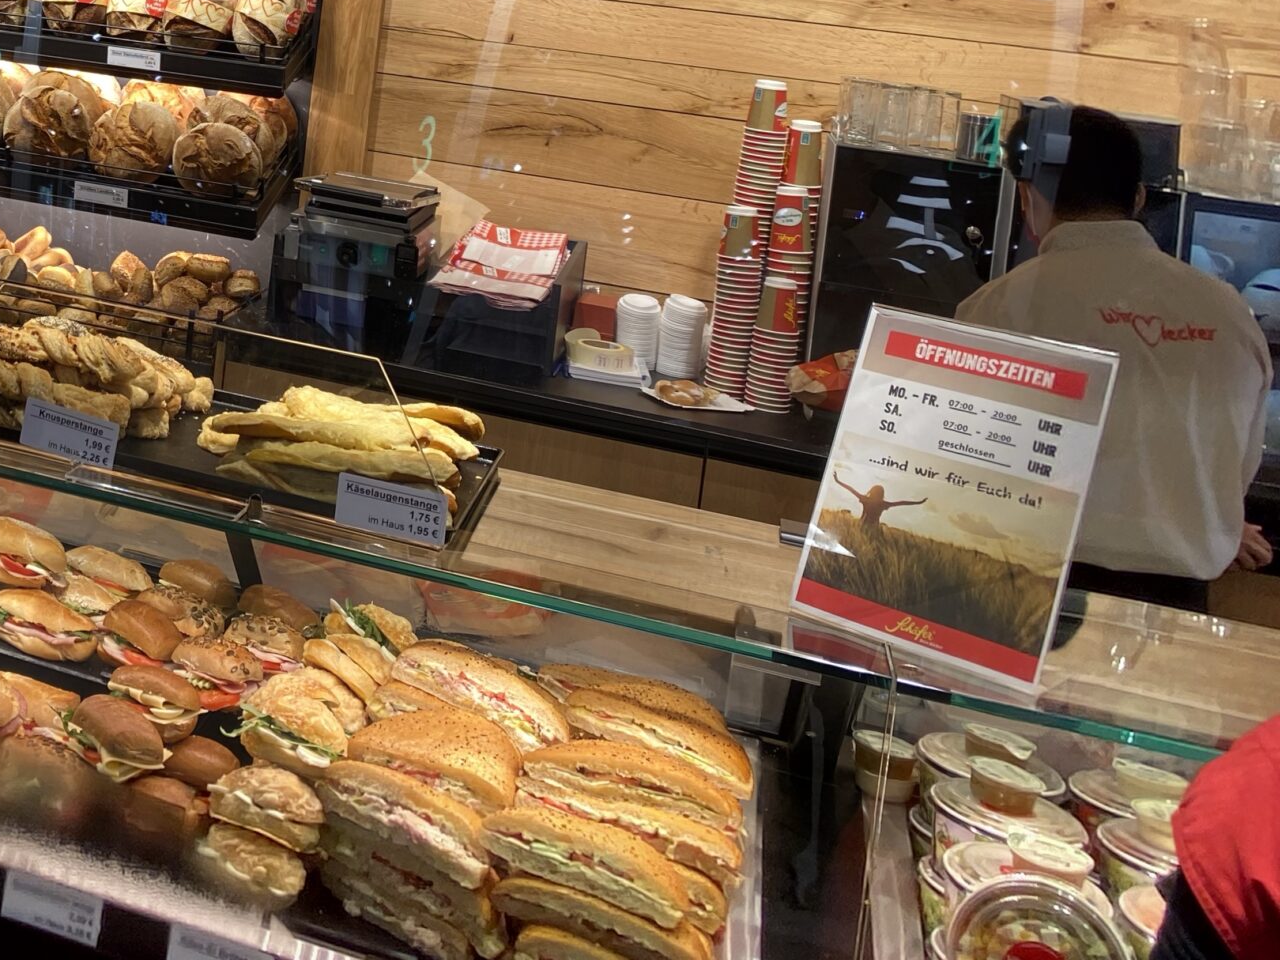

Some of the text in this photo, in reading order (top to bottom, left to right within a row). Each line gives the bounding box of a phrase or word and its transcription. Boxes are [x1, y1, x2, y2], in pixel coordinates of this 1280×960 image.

[915, 339, 1056, 390] ÖFFNUNGSZEITEN
[38, 408, 105, 436] Knusperstange
[888, 384, 1063, 436] MO. FR. 07:00 20:00 UHR
[884, 402, 1058, 458] SA. 07:00 20:00 UHR
[48, 440, 109, 466] im Haus 2,25 €
[84, 438, 112, 454] 1,99 €
[879, 419, 1053, 478] SO. geschlossen UHR
[346, 482, 439, 512] Käselaugenstange
[915, 466, 940, 479] wir
[945, 471, 970, 488] für
[976, 481, 1012, 500] Euch
[1018, 493, 1043, 509] da!
[368, 515, 438, 539] im Haus 1,95 €
[409, 510, 440, 526] 1,75 €
